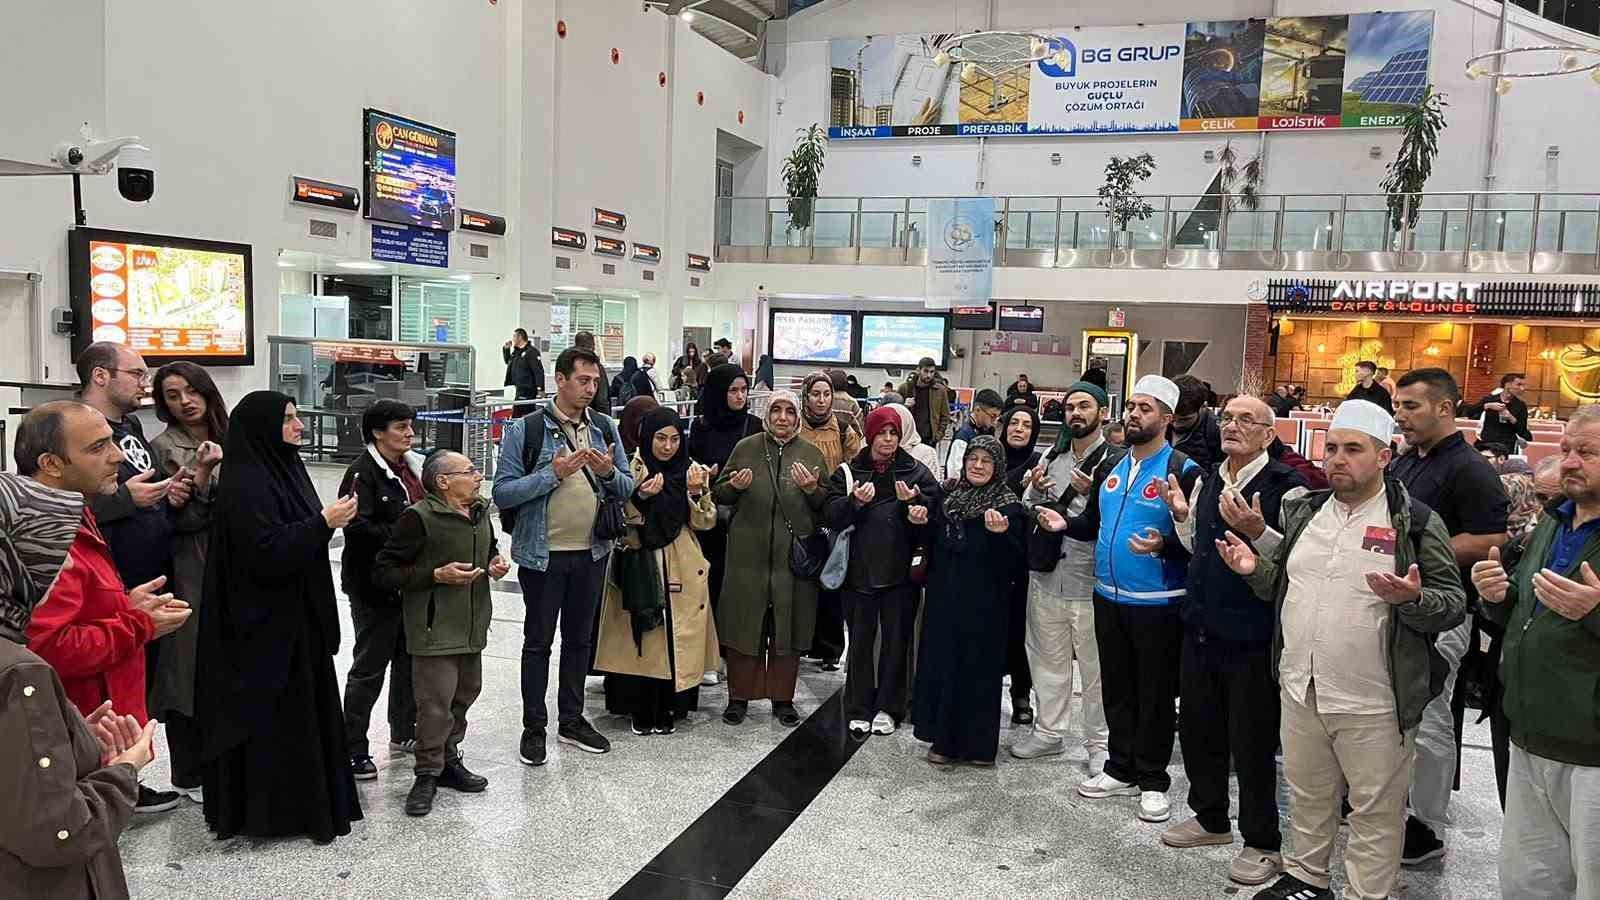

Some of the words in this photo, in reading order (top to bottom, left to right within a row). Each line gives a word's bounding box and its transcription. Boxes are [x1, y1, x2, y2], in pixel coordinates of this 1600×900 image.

[1081, 48, 1112, 63] BG
[1117, 45, 1180, 62] GRUP
[1105, 100, 1145, 111] ORTAĞI
[1200, 118, 1237, 130] ÇELİK
[1271, 116, 1326, 128] LOJİSTİK
[840, 126, 878, 139] İNŞAAT
[907, 126, 942, 136] PROJE
[962, 123, 1023, 135] PREFABRİK
[1332, 280, 1481, 300] AIRPORT
